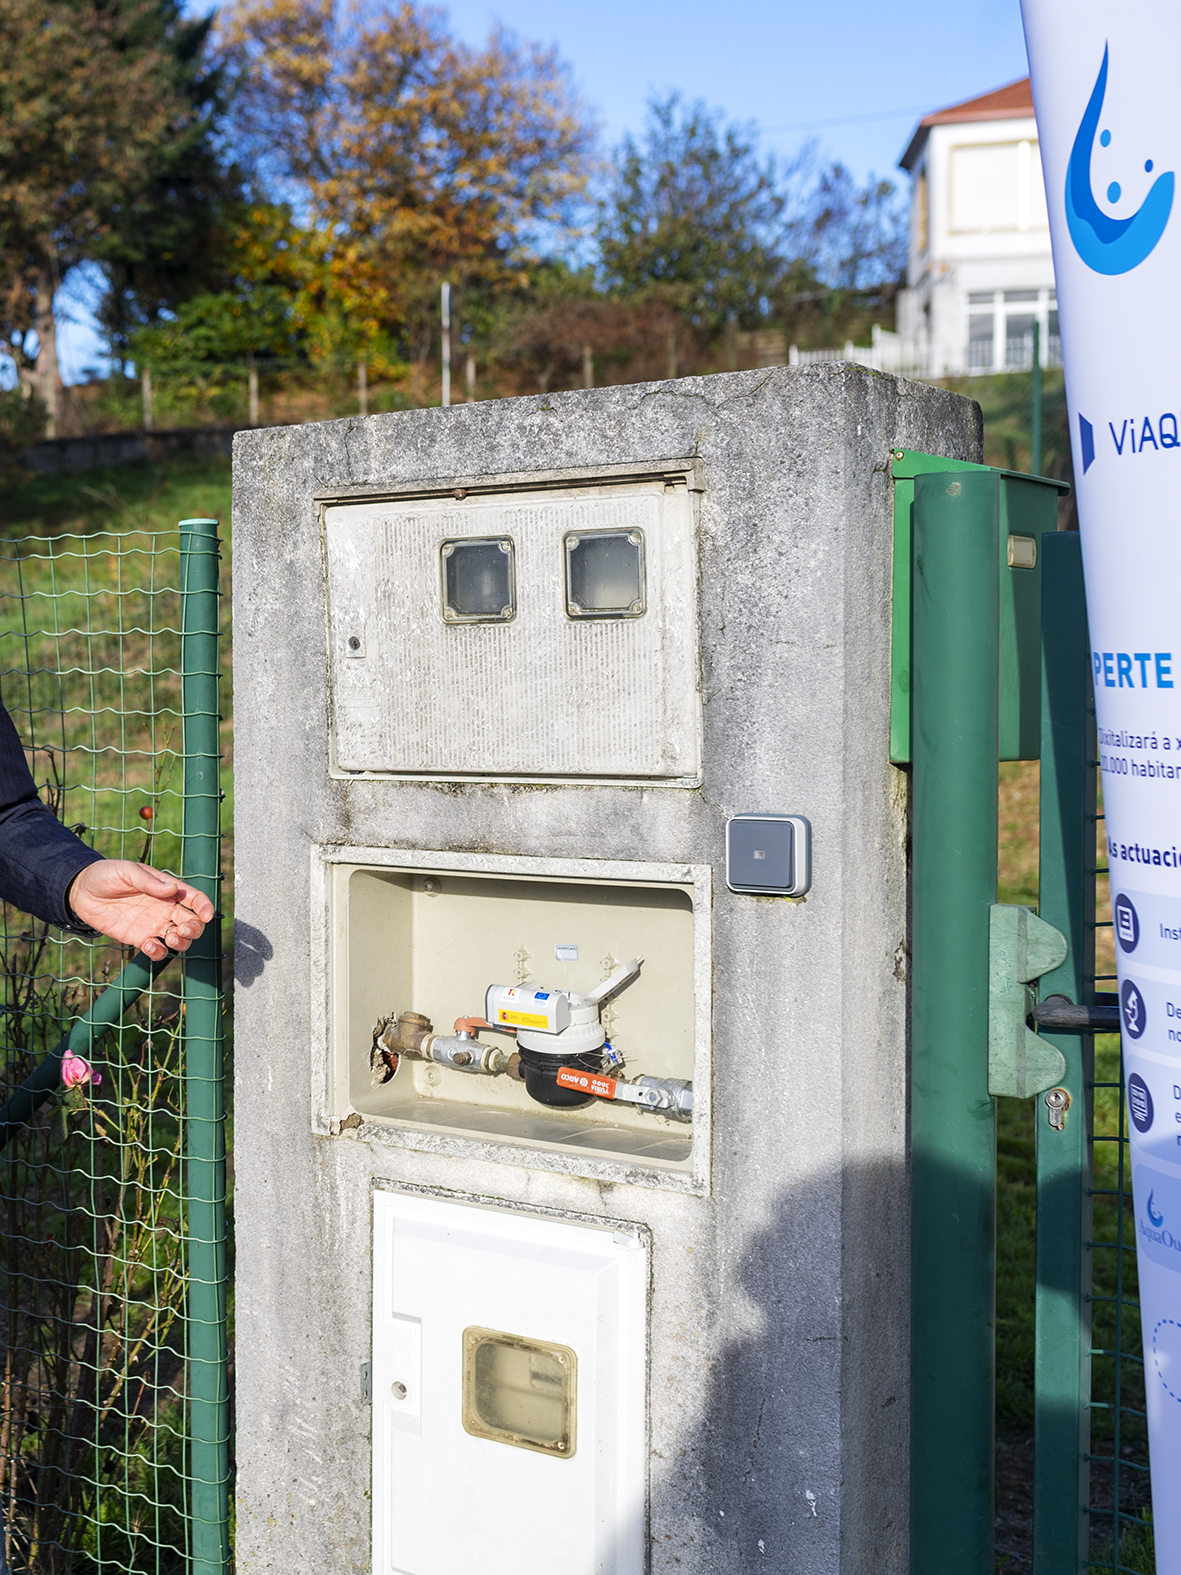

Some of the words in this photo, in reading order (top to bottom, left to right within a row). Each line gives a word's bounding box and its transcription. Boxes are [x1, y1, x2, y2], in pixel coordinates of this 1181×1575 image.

[1108, 412, 1181, 456] ViAQ
[1092, 651, 1175, 689] PERTE
[1162, 737, 1171, 750] a
[1120, 843, 1181, 868] actuaci
[560, 1073, 580, 1084] ARCO
